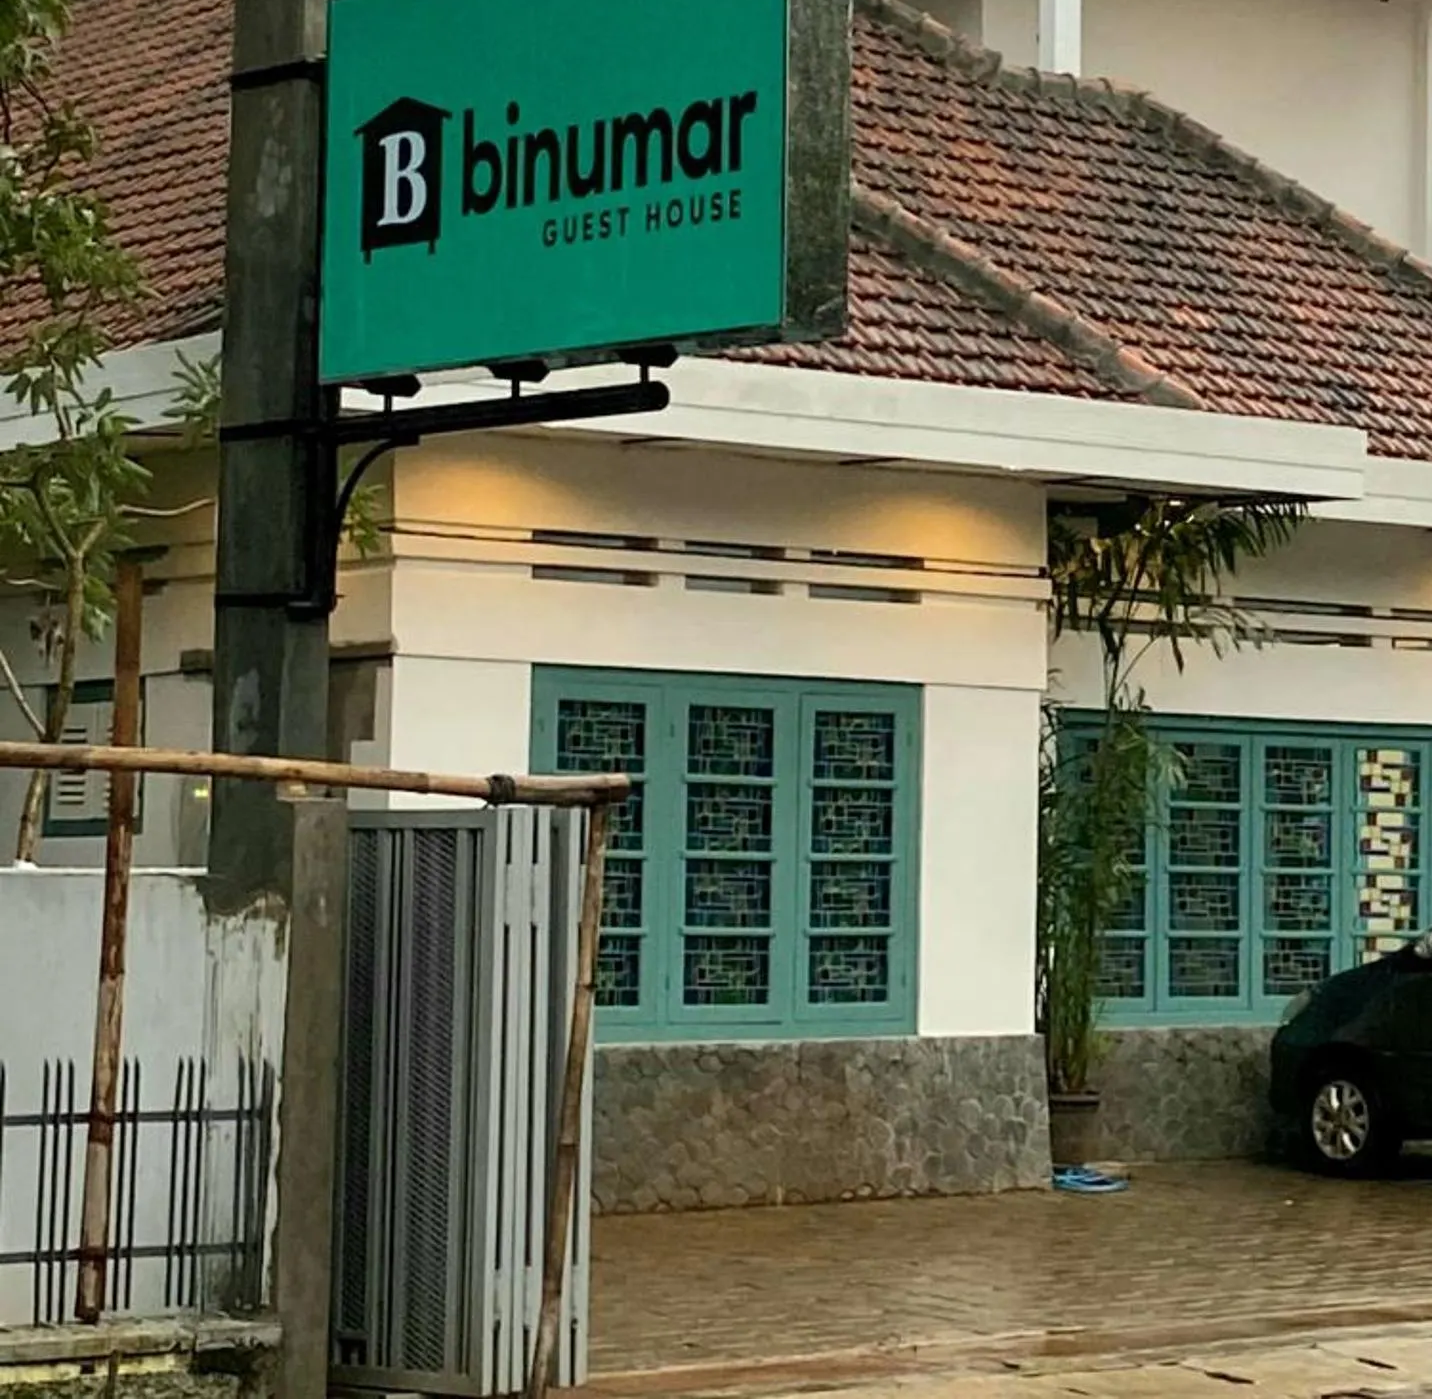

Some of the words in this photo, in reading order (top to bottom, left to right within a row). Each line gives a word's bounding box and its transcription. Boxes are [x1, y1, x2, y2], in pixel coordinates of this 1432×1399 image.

[378, 130, 427, 226] B
[462, 91, 757, 215] binumar
[543, 208, 629, 247] GUEST
[646, 190, 741, 232] HOUSE
